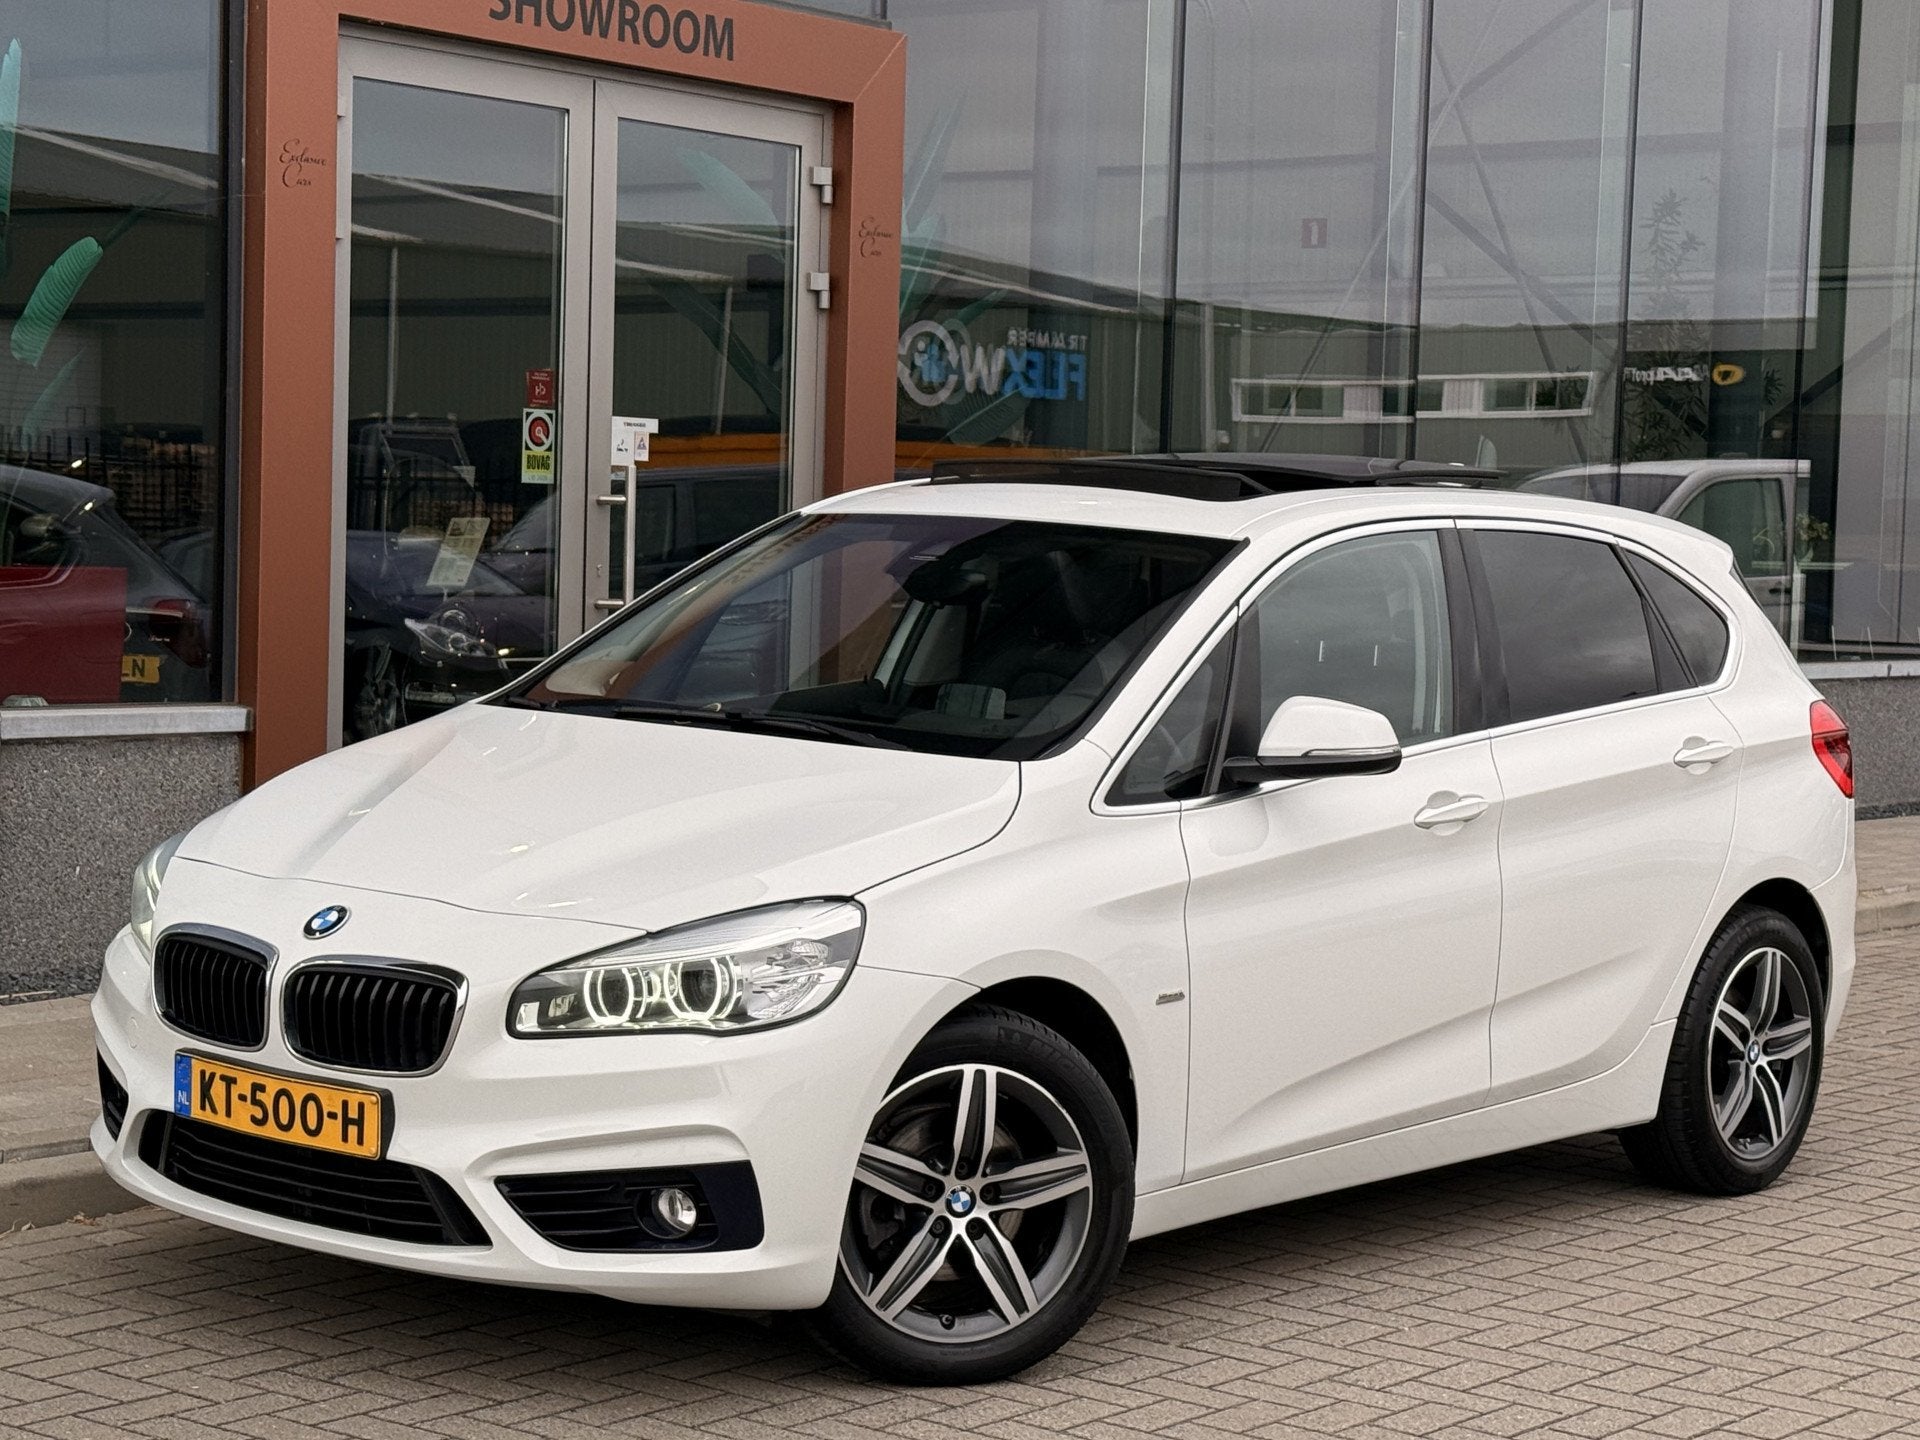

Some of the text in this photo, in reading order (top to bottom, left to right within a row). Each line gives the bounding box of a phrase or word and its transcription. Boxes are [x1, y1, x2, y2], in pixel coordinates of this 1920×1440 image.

[526, 454, 551, 471] BOVAG
[178, 1091, 190, 1105] NL
[199, 1068, 366, 1147] KT-500-H
